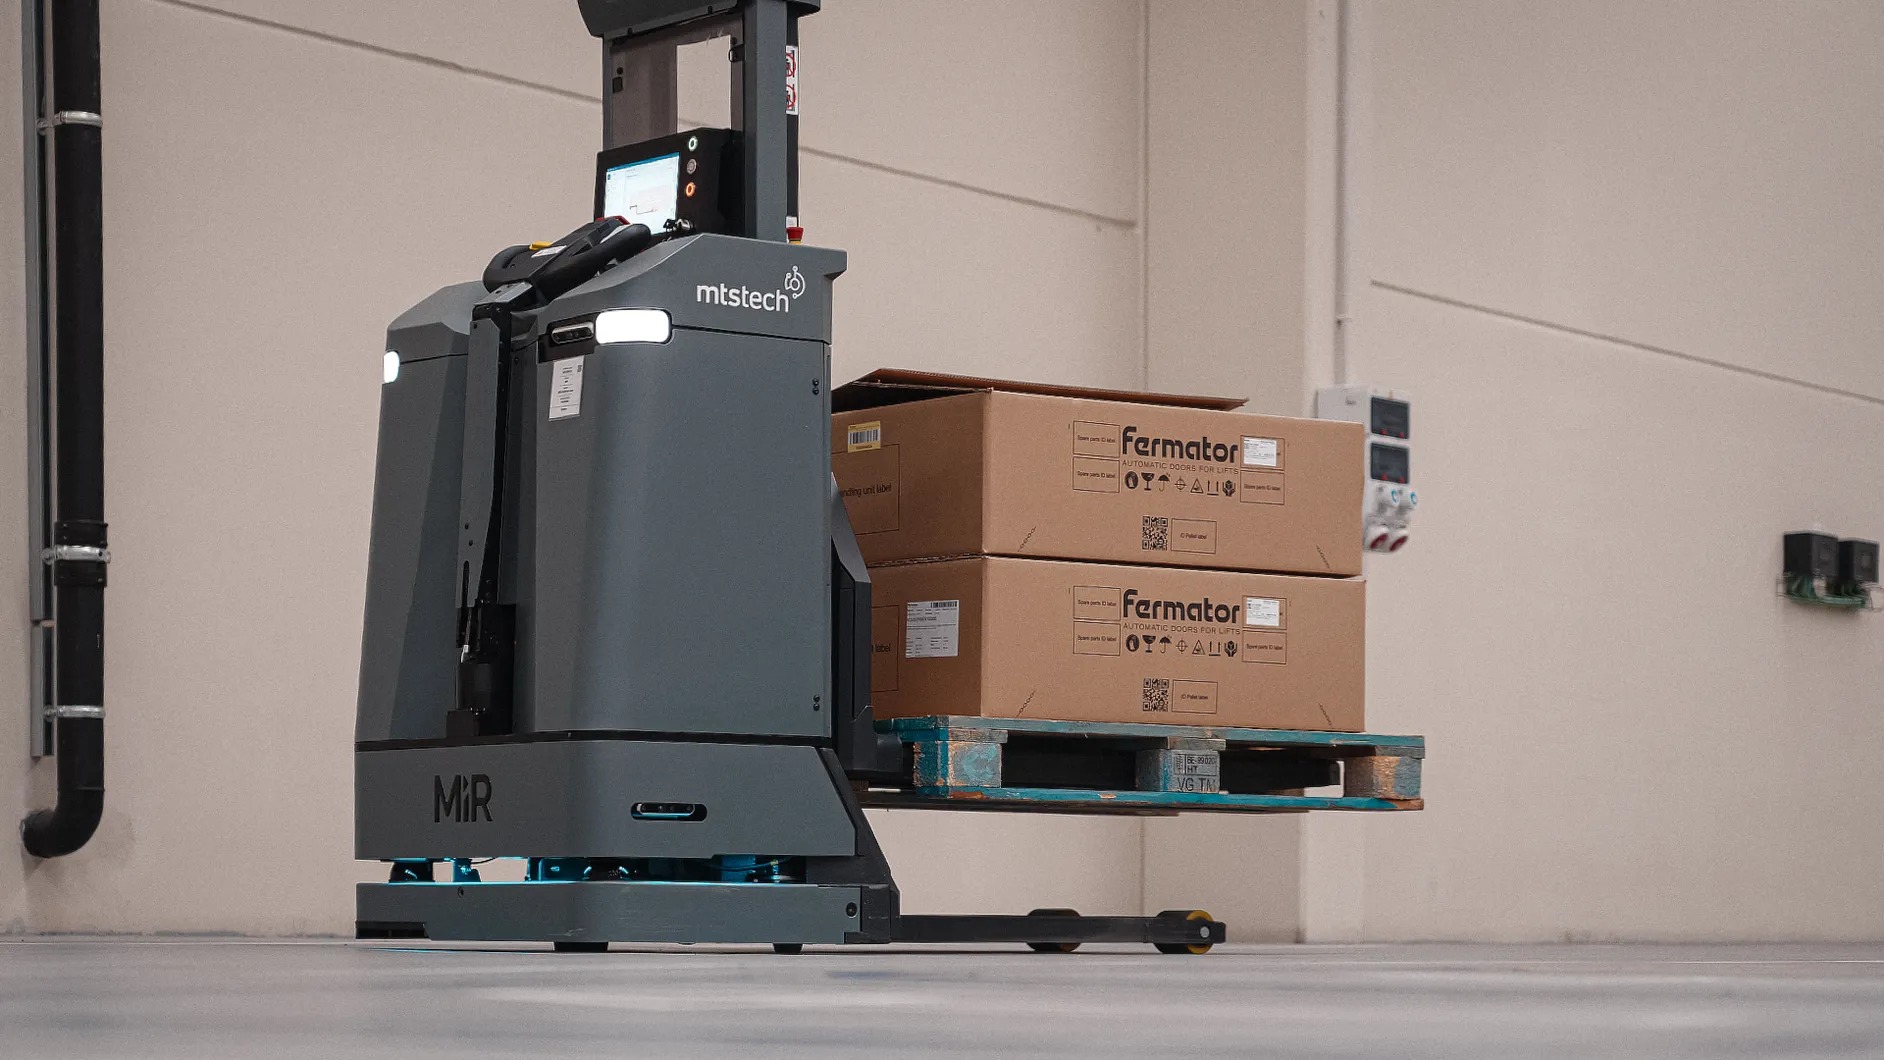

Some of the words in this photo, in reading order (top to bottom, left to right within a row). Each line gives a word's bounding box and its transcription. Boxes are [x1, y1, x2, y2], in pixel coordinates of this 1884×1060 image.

[696, 283, 789, 313] mtstech
[1122, 460, 1167, 469] AUTOMATIC
[1170, 463, 1196, 472] DOORS
[1217, 467, 1239, 475] LIFTS
[862, 486, 876, 495] unit
[876, 482, 892, 494] label
[1123, 622, 1168, 632] AUTOMATIC
[1171, 625, 1198, 634] DOORS
[1200, 626, 1216, 634] FOR
[874, 642, 891, 653] label
[433, 773, 494, 823] MiR
